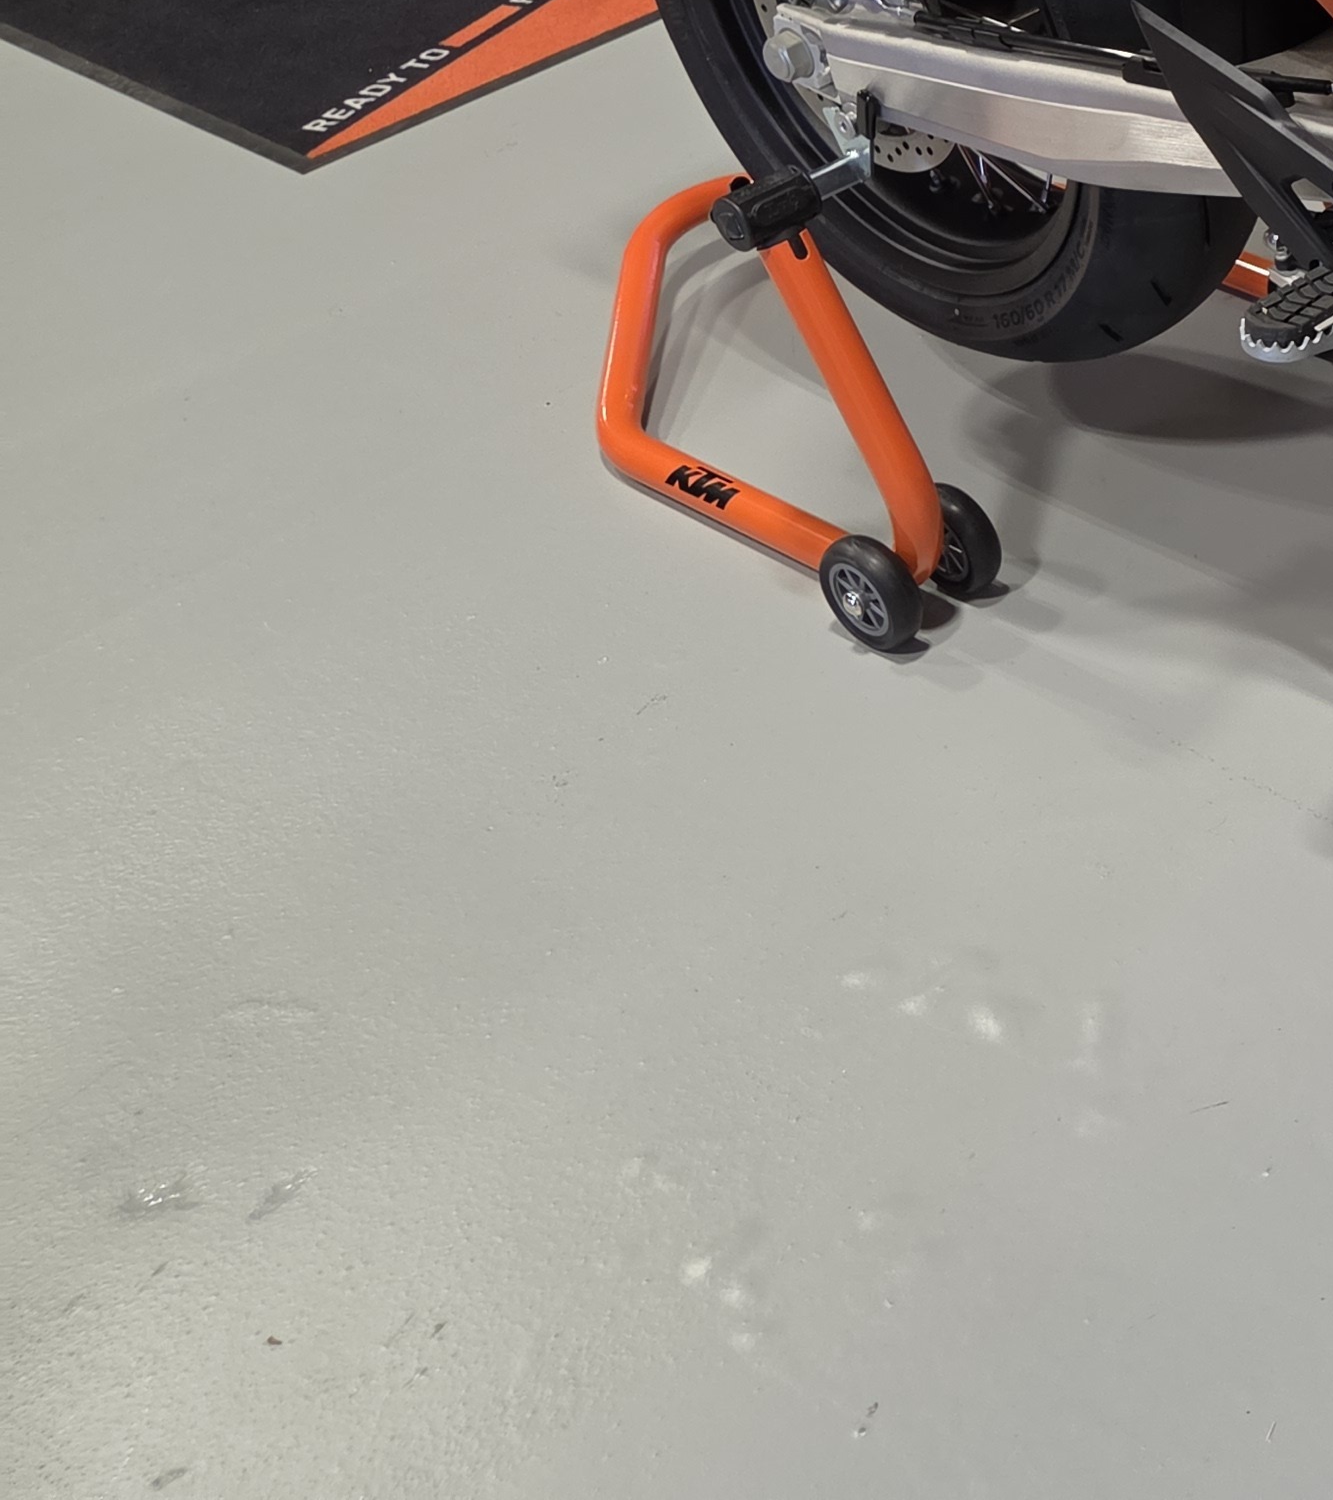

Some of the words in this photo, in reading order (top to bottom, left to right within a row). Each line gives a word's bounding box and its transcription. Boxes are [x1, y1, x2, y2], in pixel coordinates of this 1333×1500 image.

[302, 72, 408, 132] READY
[400, 47, 450, 70] TO
[664, 464, 741, 510] KTM
